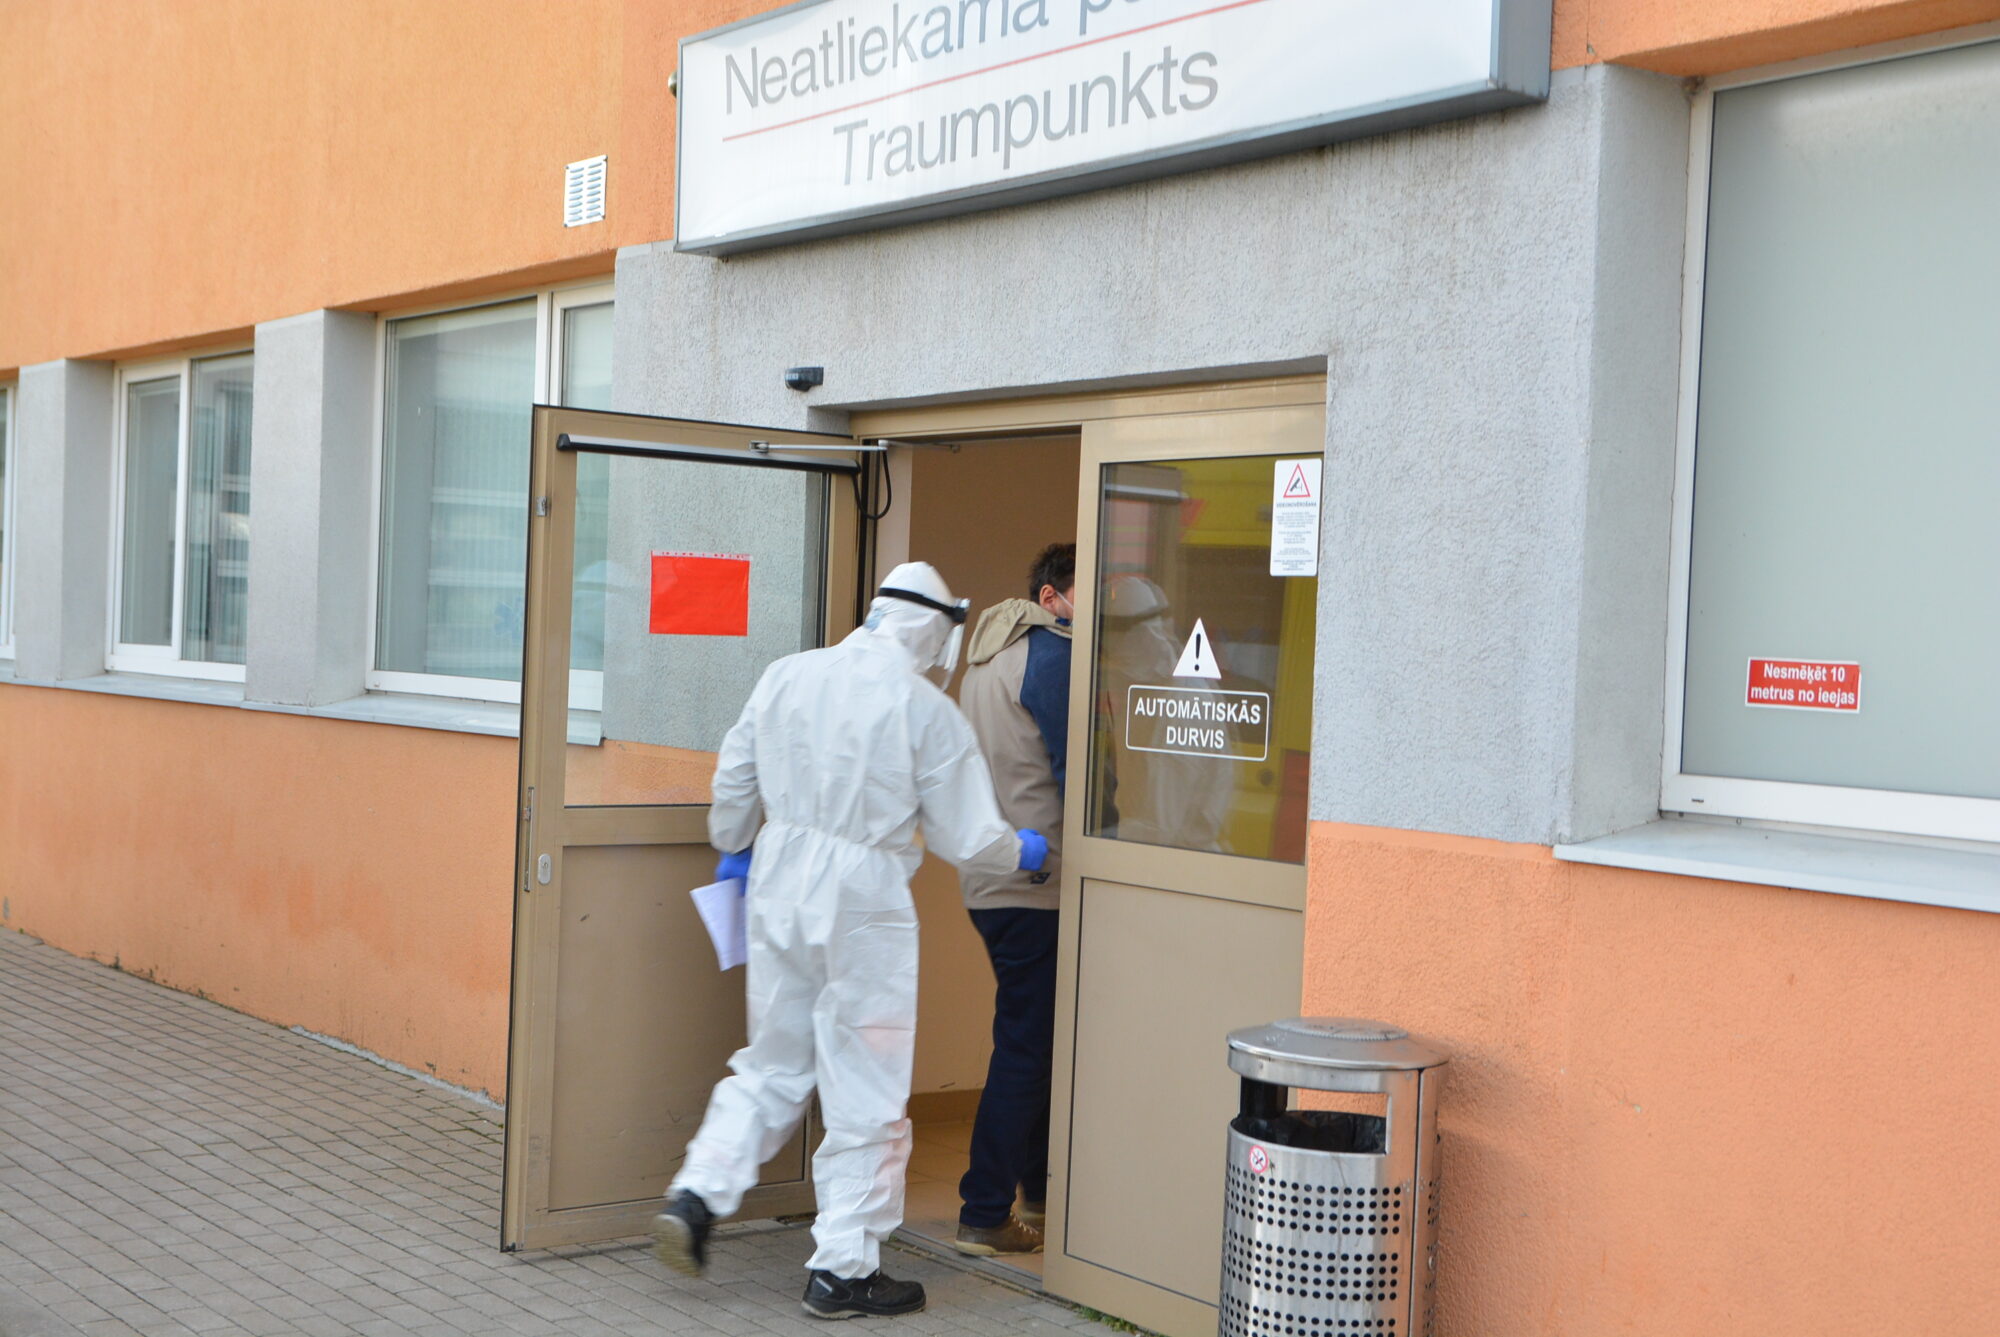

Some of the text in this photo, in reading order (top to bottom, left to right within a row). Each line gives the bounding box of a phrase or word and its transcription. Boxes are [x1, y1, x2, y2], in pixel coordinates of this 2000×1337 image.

[833, 46, 1219, 186] Traumpunkts
[1763, 662, 1846, 685] Nesmēķēt 10
[1750, 684, 1795, 701] metrus
[1798, 689, 1815, 703] no
[1134, 696, 1261, 725] AUTOMĀTISKĀS
[1166, 725, 1225, 749] DURVIS
